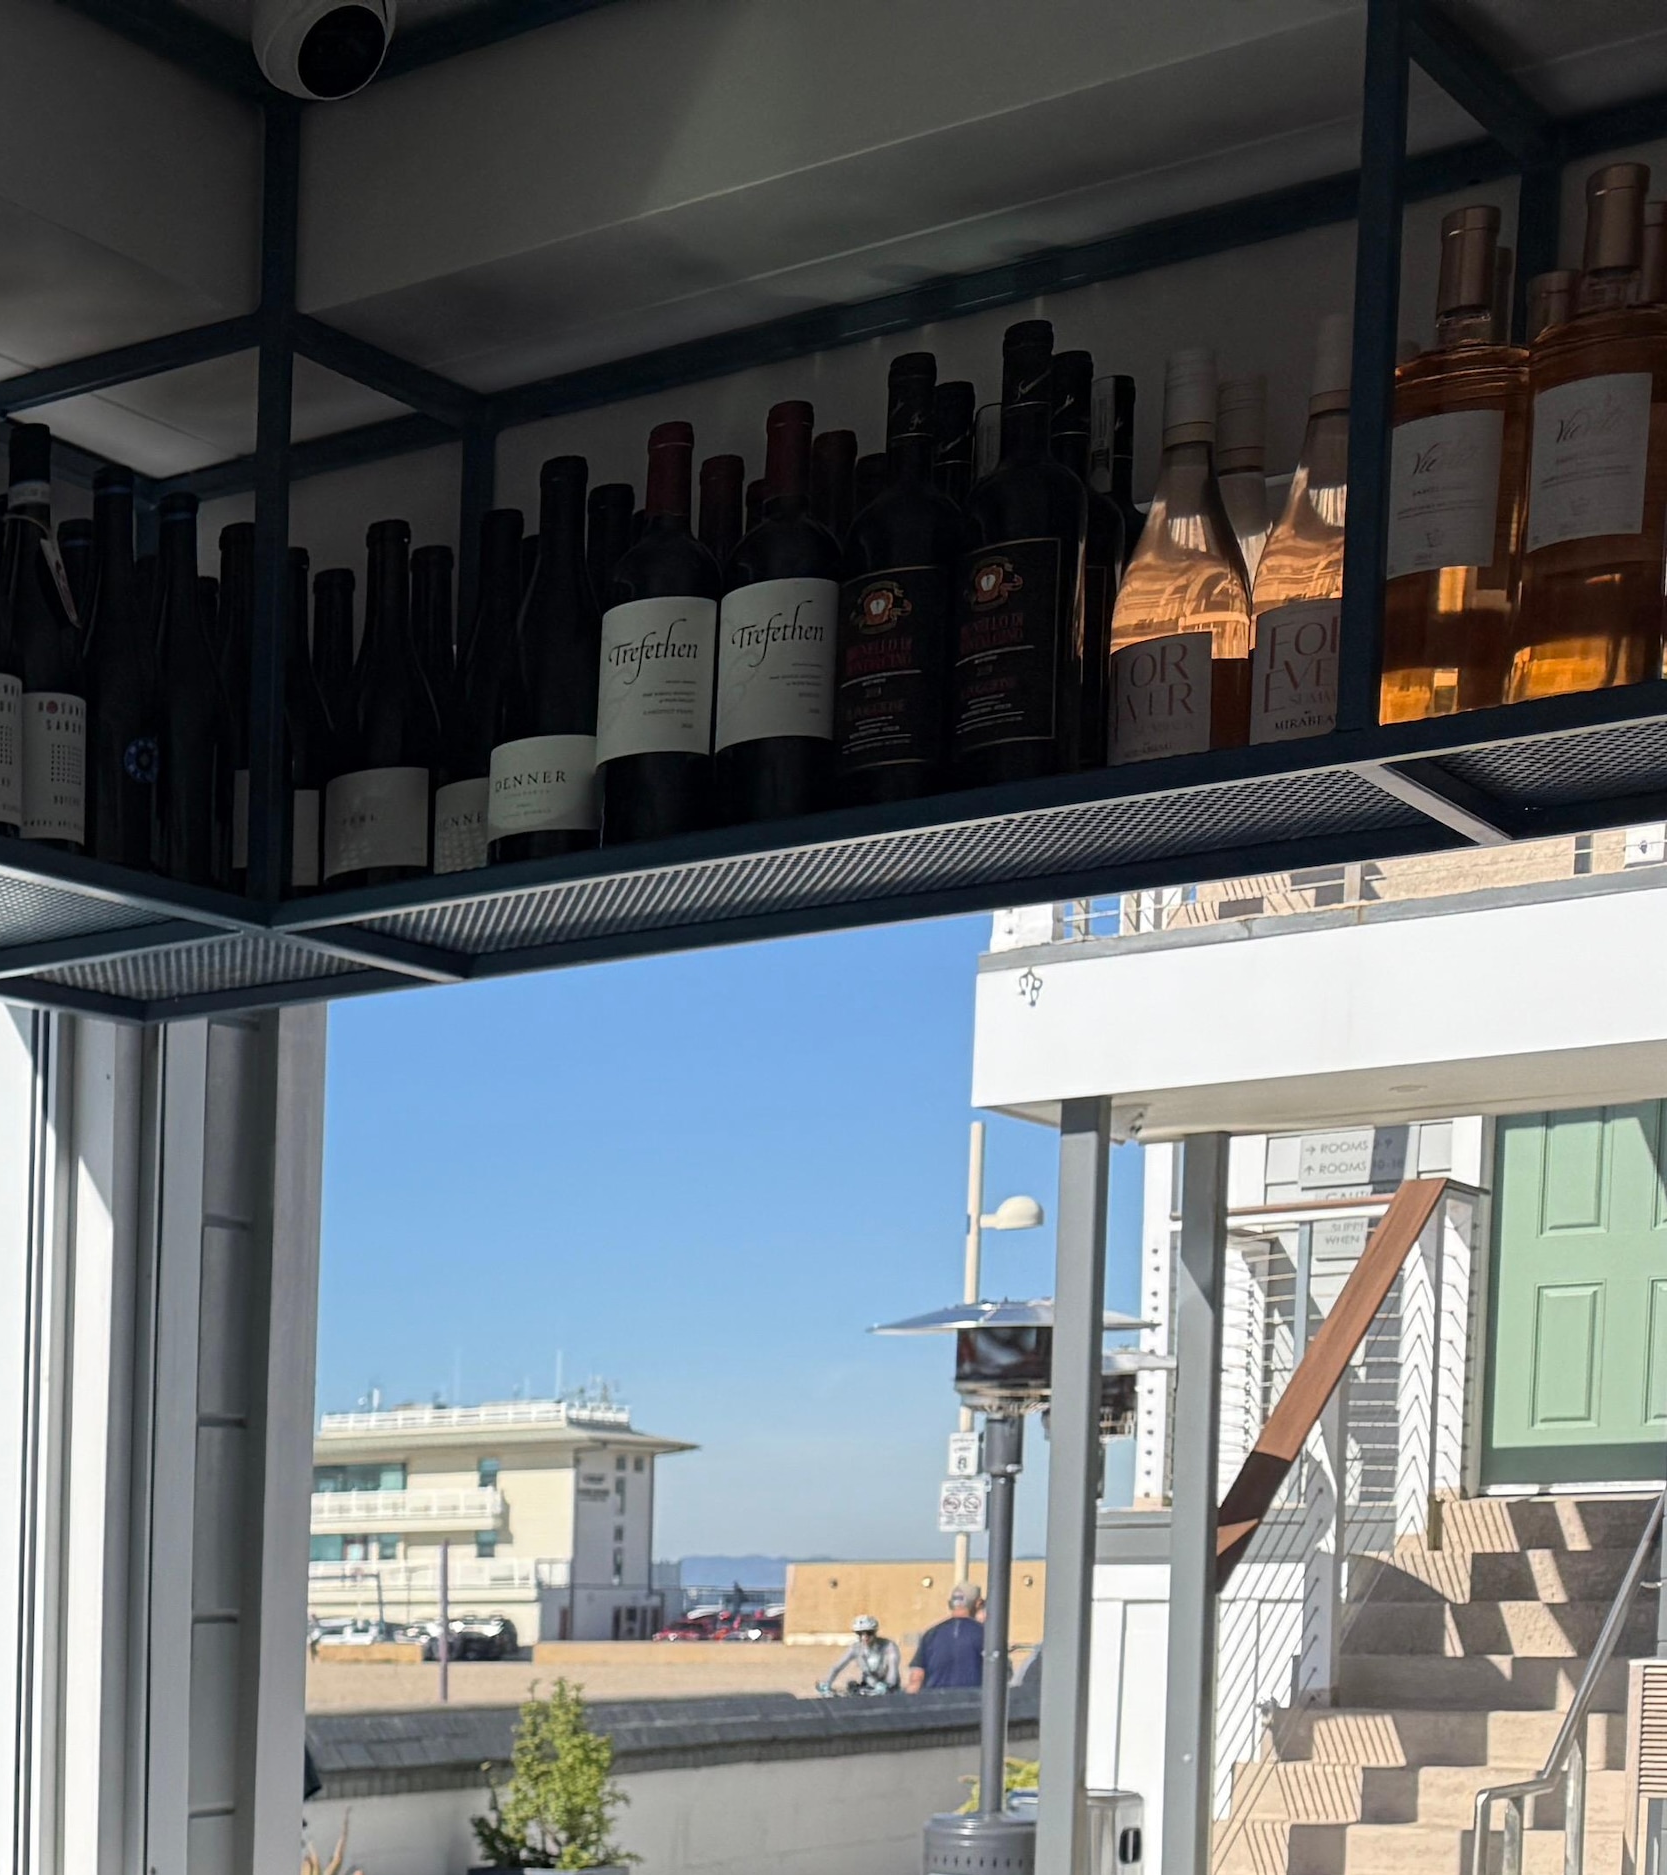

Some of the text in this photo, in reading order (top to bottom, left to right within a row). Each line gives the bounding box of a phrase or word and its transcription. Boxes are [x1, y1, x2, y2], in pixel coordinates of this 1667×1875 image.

[732, 600, 824, 668] Trefethen
[609, 618, 698, 686] Trefethen
[495, 770, 567, 793] DENNER
[1320, 1140, 1369, 1154] ROOMS
[1318, 1161, 1367, 1175] ROOMS
[1325, 1233, 1361, 1246] WHEN
